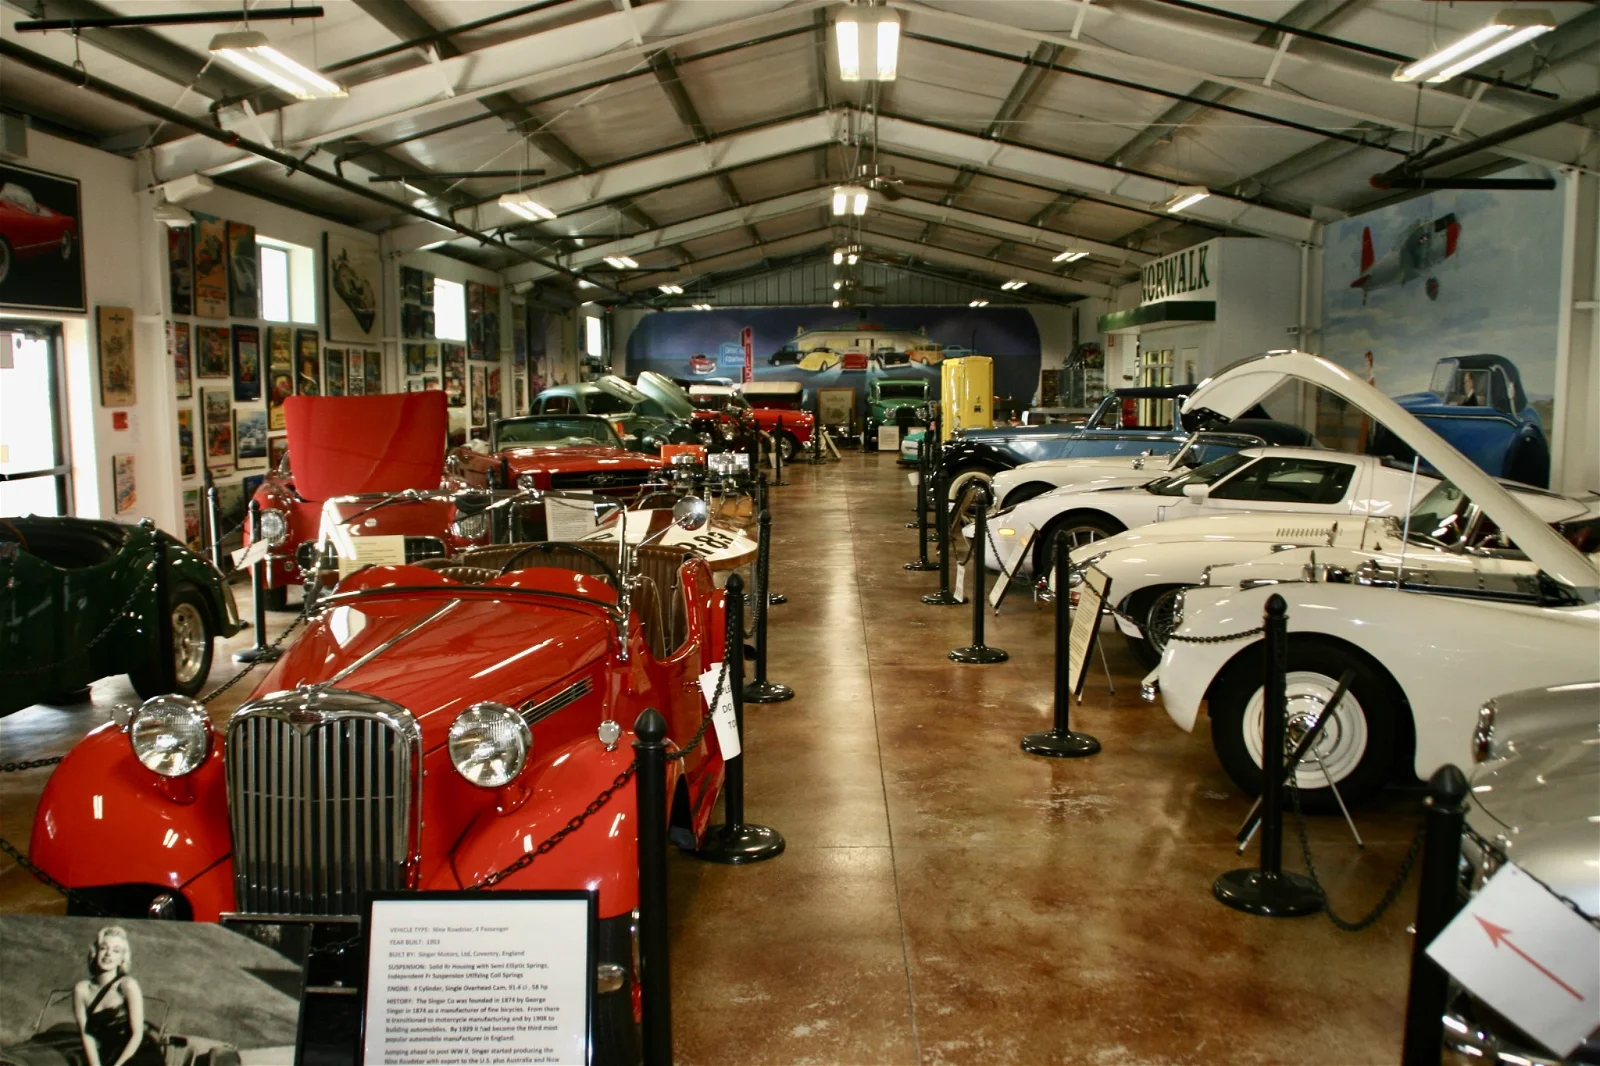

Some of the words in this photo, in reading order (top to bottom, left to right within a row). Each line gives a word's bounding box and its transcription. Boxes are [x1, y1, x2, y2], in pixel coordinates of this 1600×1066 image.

[1141, 245, 1210, 302] NORWALK
[722, 703, 732, 713] DO
[418, 951, 436, 959] Singer
[473, 950, 501, 958] Coventry,
[502, 972, 524, 980] Springs
[492, 1057, 505, 1065] plus
